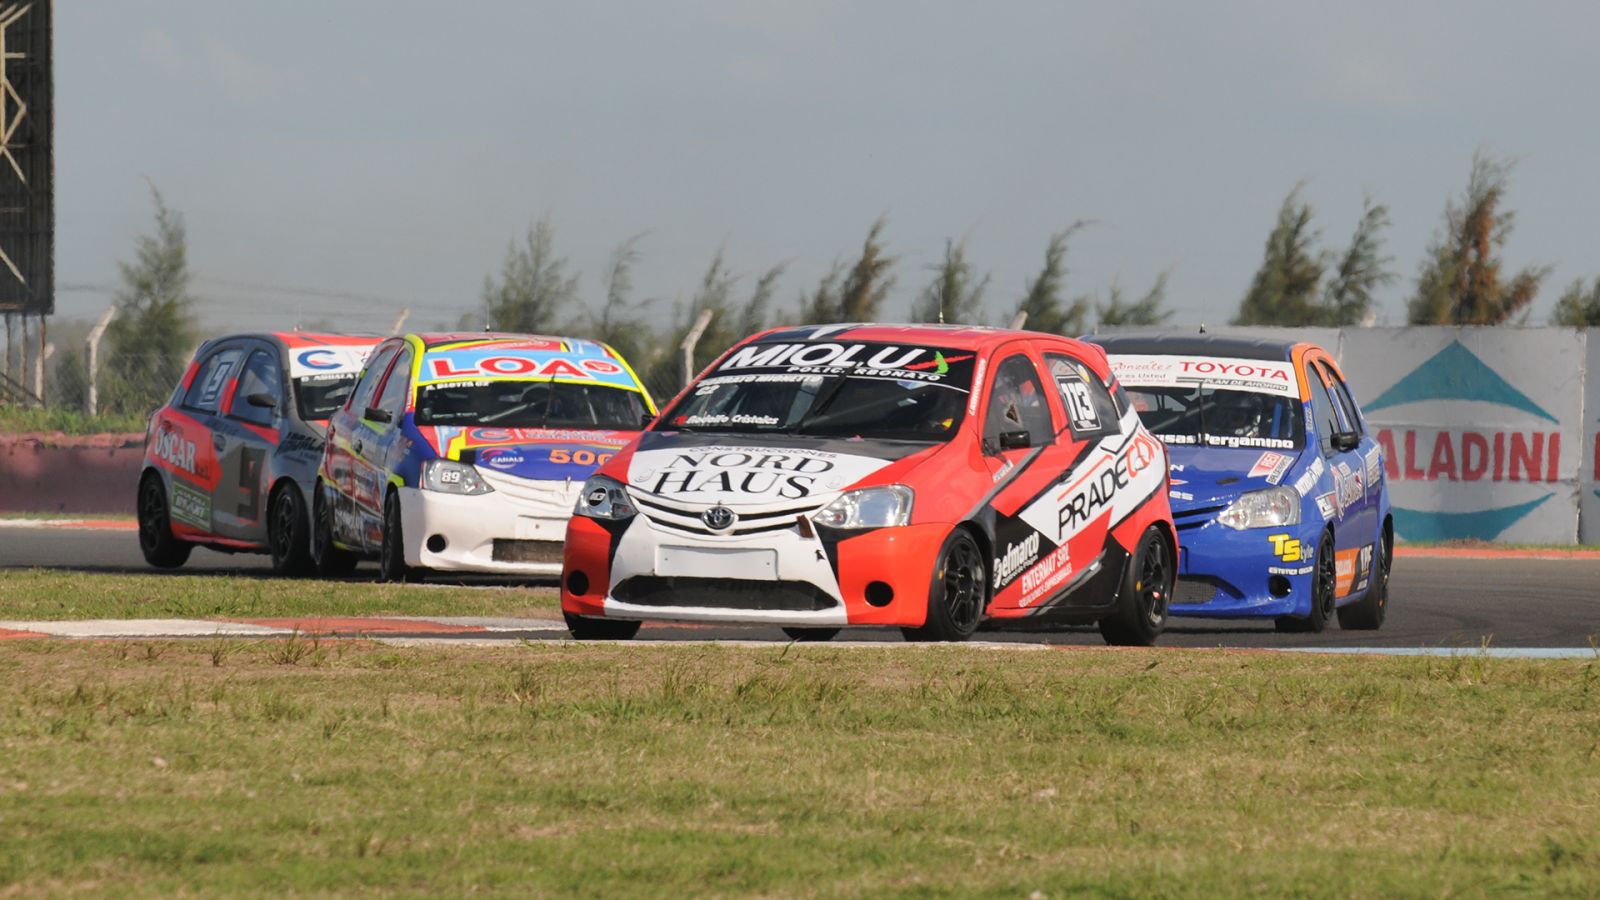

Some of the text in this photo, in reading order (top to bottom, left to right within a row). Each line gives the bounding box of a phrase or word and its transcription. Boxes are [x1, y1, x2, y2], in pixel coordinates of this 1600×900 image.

[787, 366, 941, 382] POLICRBONATO
[1180, 361, 1289, 382] TOYOTA
[1060, 382, 1096, 421] 113
[664, 452, 834, 473] NORD
[441, 471, 460, 483] 89
[652, 470, 816, 499] HAUS
